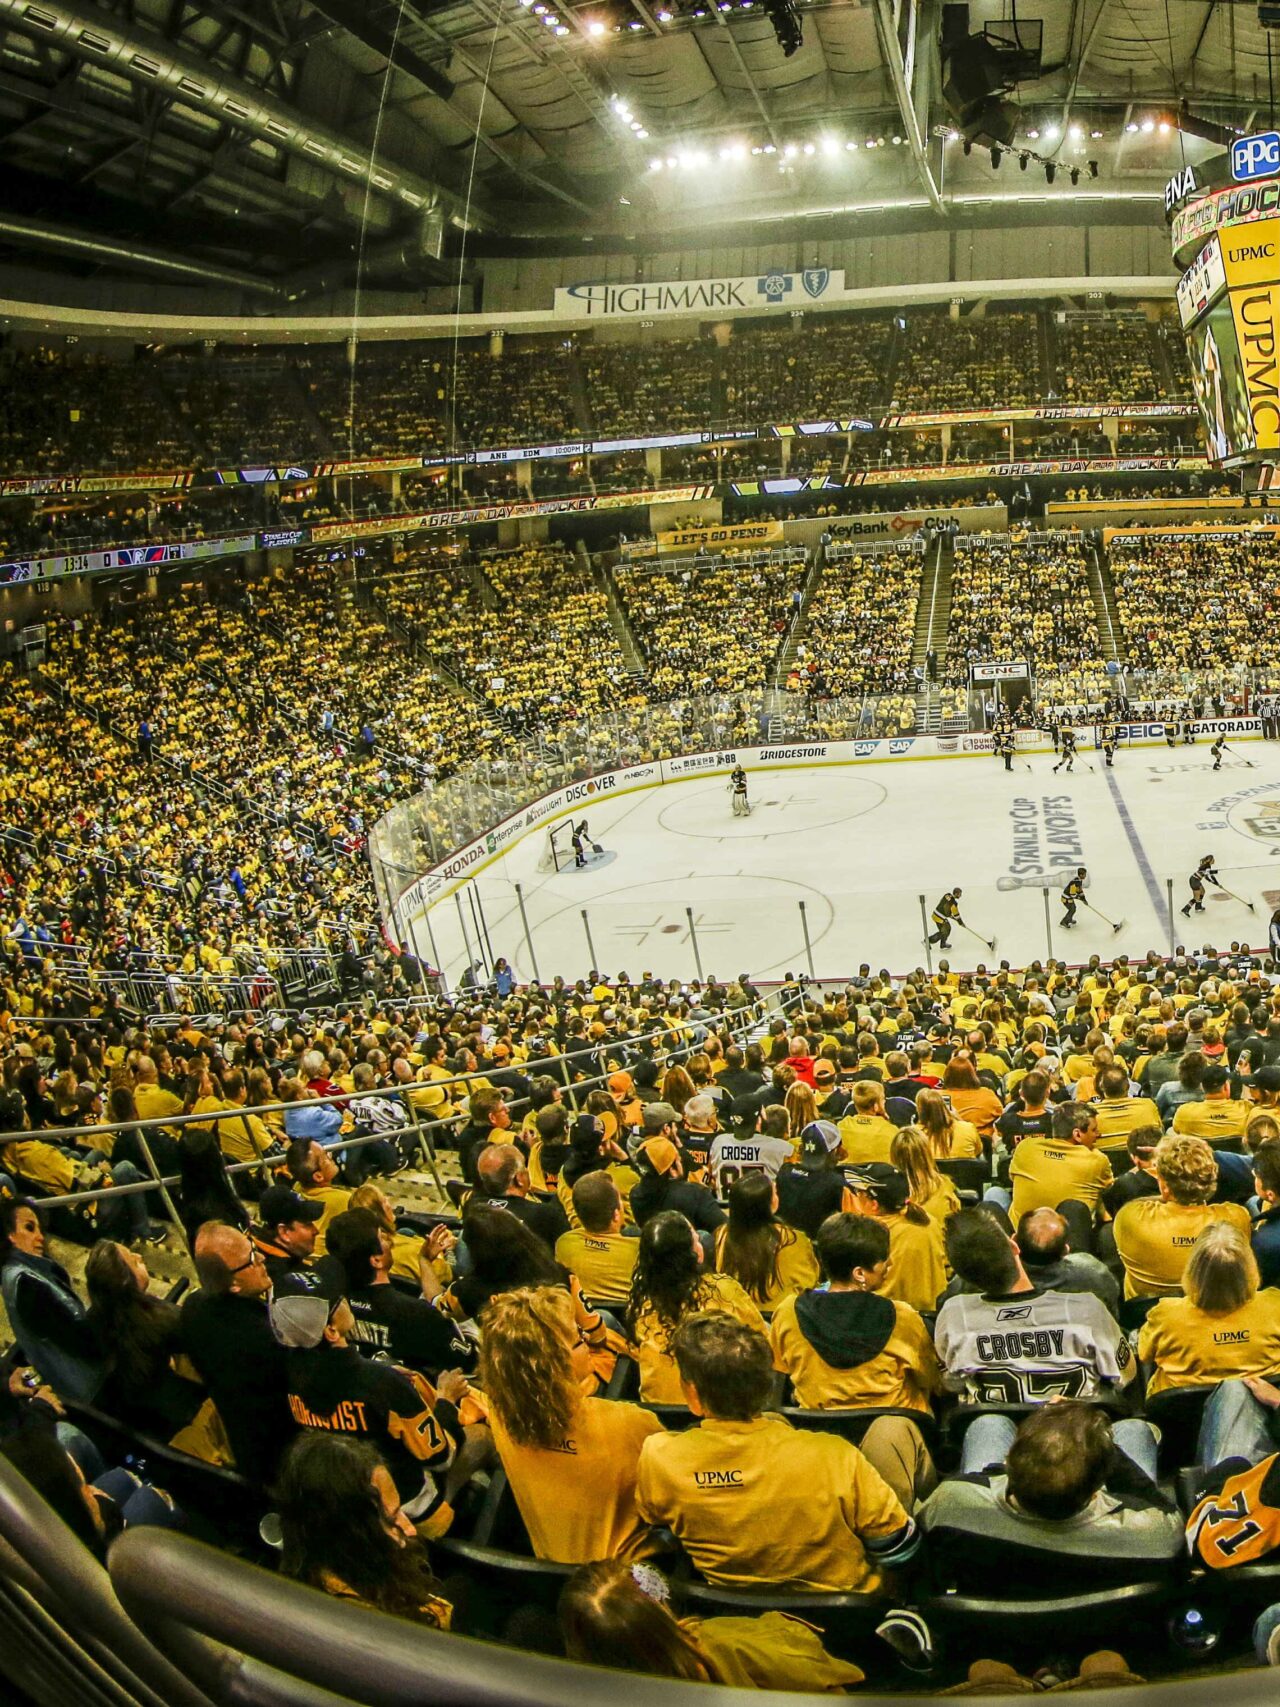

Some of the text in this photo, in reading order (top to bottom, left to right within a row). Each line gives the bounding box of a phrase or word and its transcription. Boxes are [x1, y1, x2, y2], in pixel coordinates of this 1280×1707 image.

[1235, 139, 1280, 174] PPG
[1228, 243, 1276, 263] UPMC
[586, 280, 746, 315] HIGHMARK
[640, 320, 654, 328] 233
[490, 329, 505, 337] 232
[1238, 290, 1280, 436] UPMC
[1034, 407, 1127, 418] A GREAT DAY
[490, 445, 581, 460] ANH EDM 10:00PM
[999, 462, 1052, 475] GREAT
[1060, 461, 1091, 472] DAY
[1093, 461, 1113, 469] FOR
[1115, 458, 1179, 471] HOCKEY.
[419, 518, 428, 527] A
[429, 512, 478, 526] GREAT
[486, 506, 515, 520] DAY
[264, 532, 290, 542] STANLEY
[290, 531, 302, 540] CUP
[674, 527, 768, 546] LET'S GO PENS!
[828, 522, 889, 538] KeyBank
[1184, 532, 1239, 543] PLAYOFFS
[268, 538, 298, 548] PLAYOFFS
[897, 542, 911, 552] 122
[972, 537, 986, 547] 101
[37, 553, 111, 577] 1 13:14 0
[147, 567, 160, 577] 119
[981, 666, 1021, 675] GNC
[1192, 719, 1262, 734] GATORADE
[759, 747, 827, 761] BRIDGESTONE
[855, 742, 877, 756] SAP
[890, 740, 911, 753] SAP
[725, 753, 736, 764] 88
[565, 775, 616, 804] DISCOVER
[546, 796, 563, 812] LIGHT
[1207, 794, 1236, 813] PPG
[488, 818, 524, 851] enterprise
[1009, 798, 1044, 875] STANLEY CUP
[1042, 795, 1086, 868] PLAYOFFS
[443, 844, 485, 880] HONDA
[402, 881, 428, 920] UPMC
[721, 1145, 761, 1162] CROSBY
[1044, 1150, 1066, 1160] UPMC
[584, 1238, 611, 1250] UPMC
[1213, 1329, 1250, 1344] UPMC
[977, 1328, 1064, 1362] CROSBY
[694, 1469, 743, 1486] UPMC
[1206, 1490, 1264, 1558] 71
